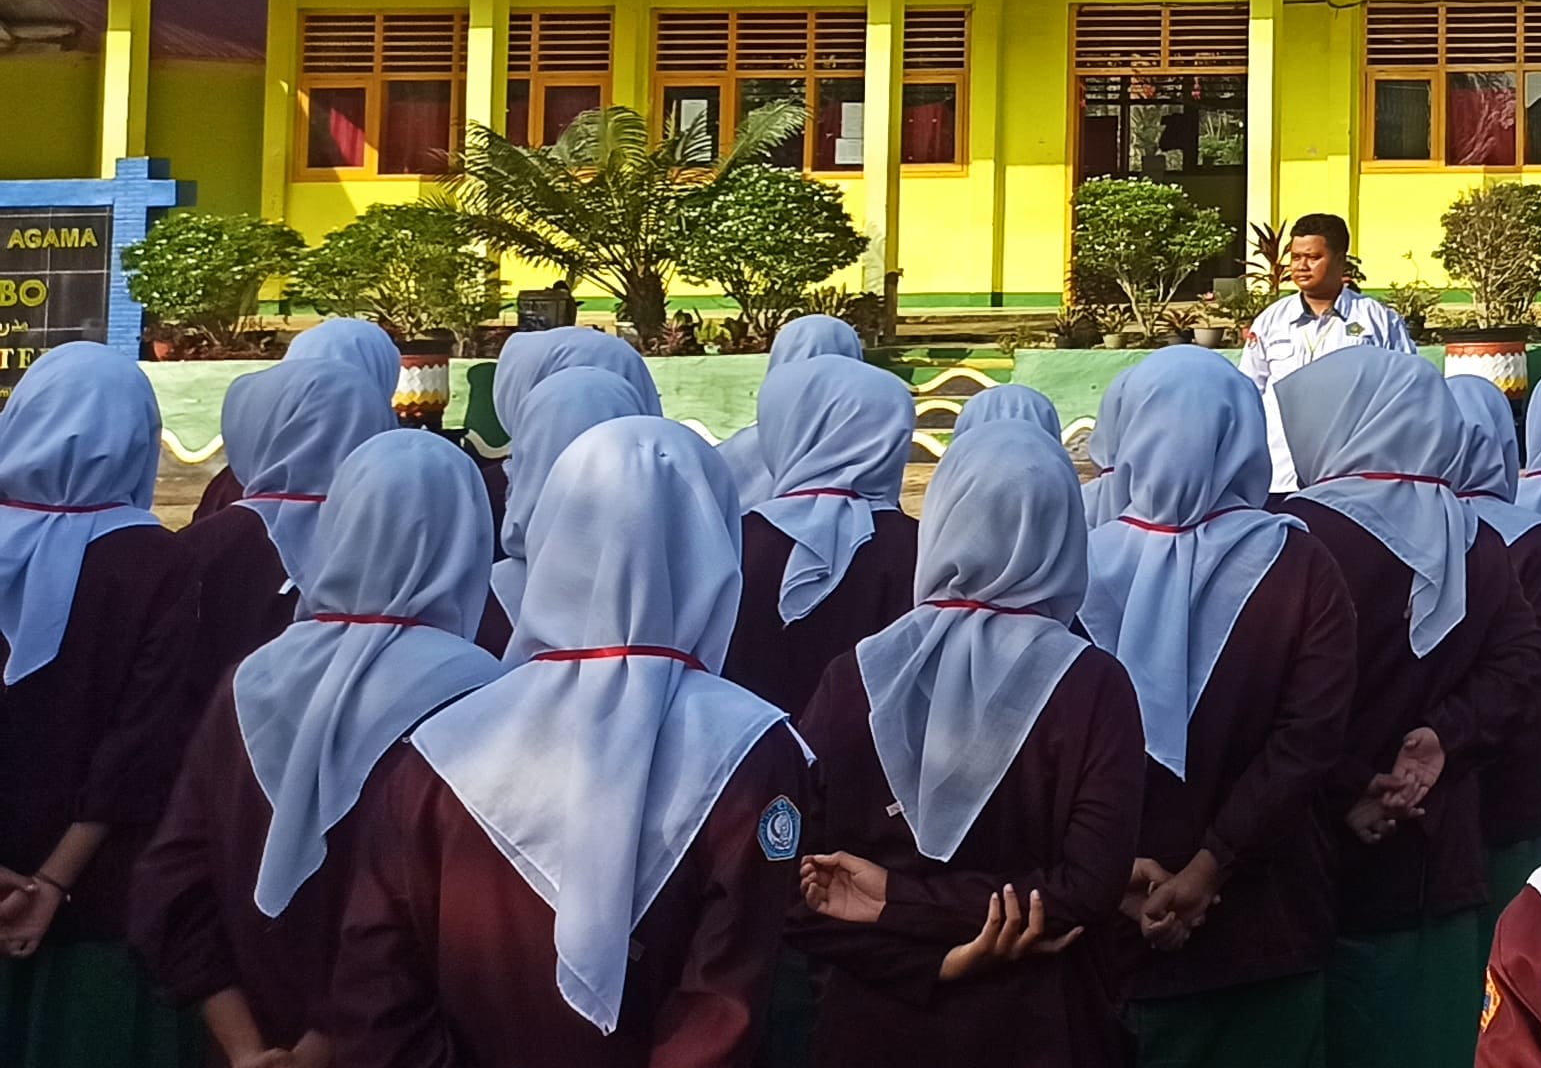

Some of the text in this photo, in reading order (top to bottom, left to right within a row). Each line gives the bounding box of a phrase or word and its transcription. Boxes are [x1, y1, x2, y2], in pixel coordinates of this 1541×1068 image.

[7, 228, 98, 249] AGAMA
[0, 279, 47, 307] BO
[0, 348, 52, 369] TE
